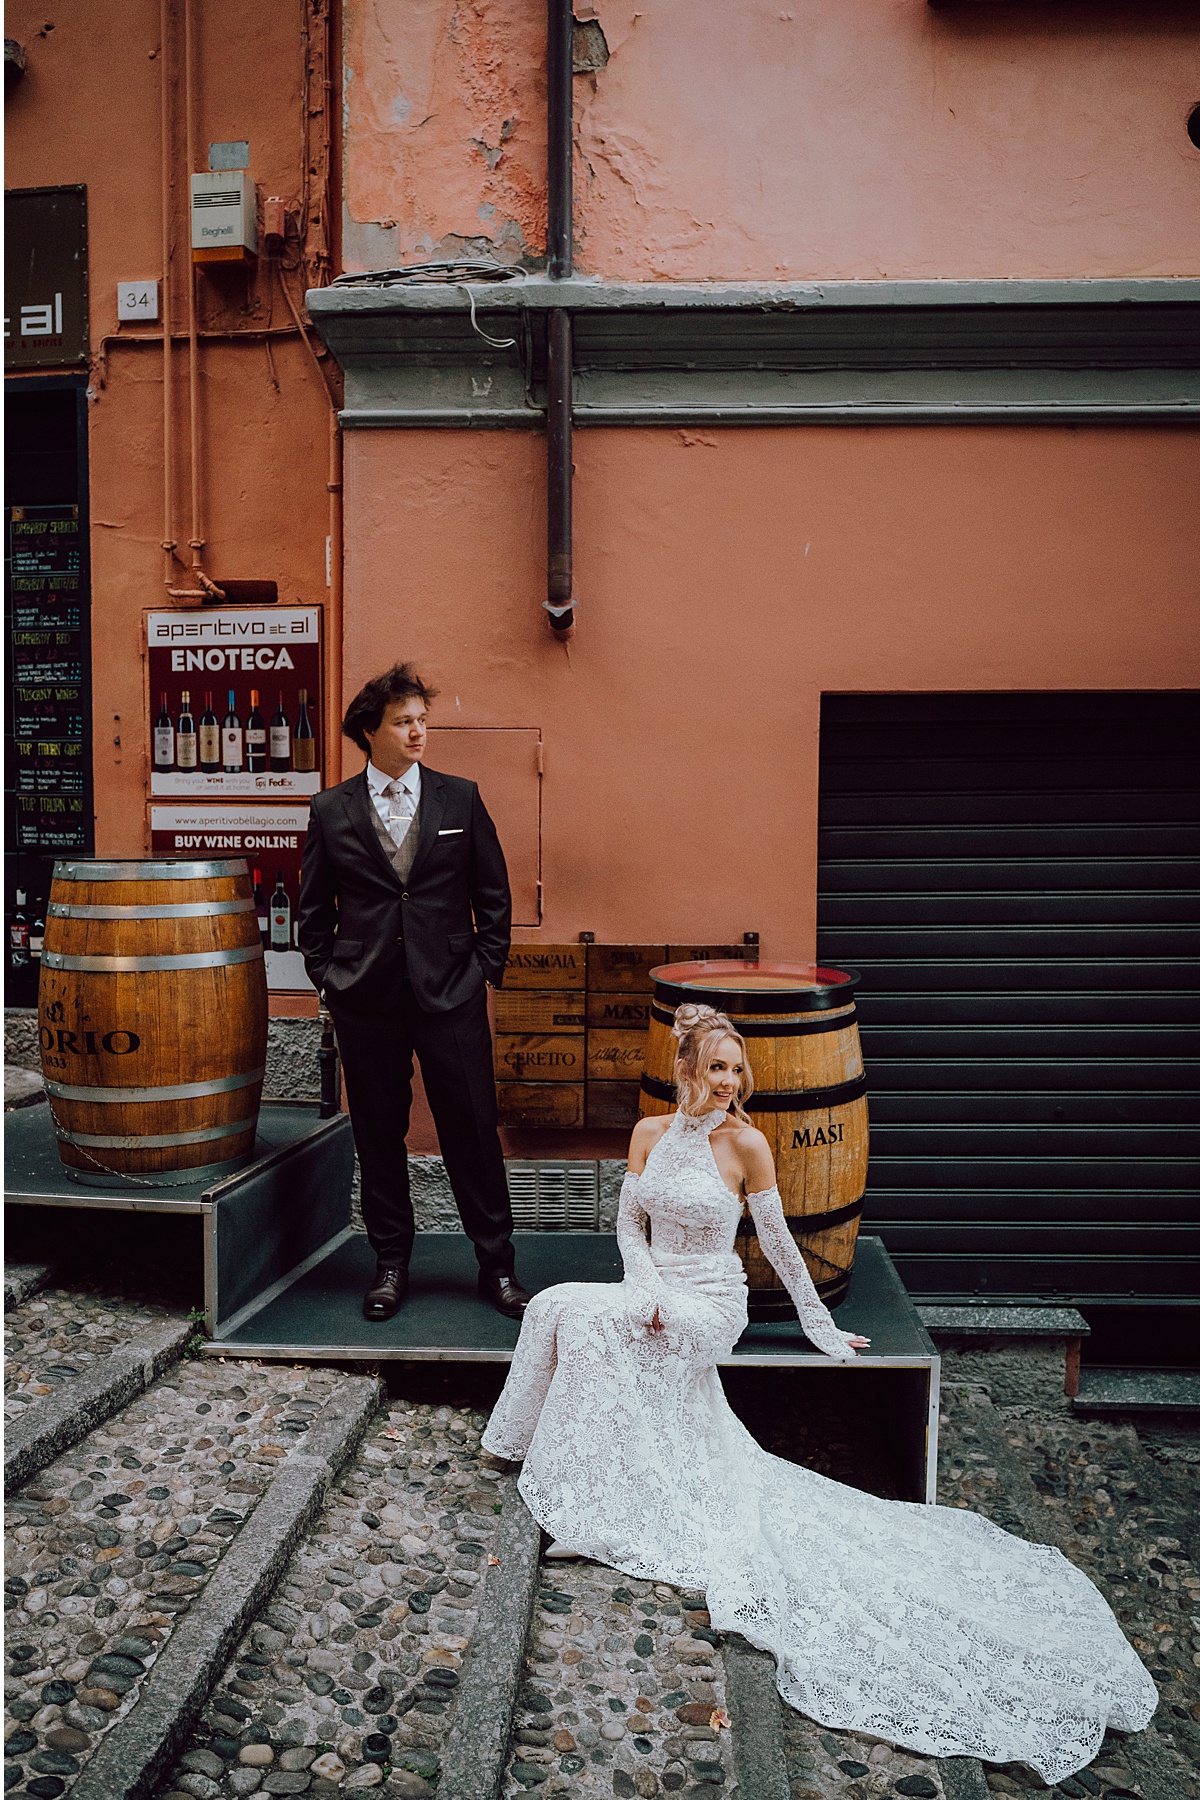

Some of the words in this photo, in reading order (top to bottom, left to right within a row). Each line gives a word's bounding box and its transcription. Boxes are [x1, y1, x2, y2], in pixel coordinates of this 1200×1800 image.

[201, 225, 234, 239] Beghelli
[126, 292, 149, 308] 34
[156, 618, 265, 640] aperitivo
[290, 616, 309, 634] al
[171, 647, 295, 672] ENOTECA
[268, 778, 293, 787] FedEx
[174, 816, 298, 829] www.aperitivobellagio.com
[174, 835, 202, 848] BUY
[202, 835, 242, 849] WINE
[244, 835, 299, 849] ONLINE
[603, 1004, 651, 1020] MASI
[791, 1122, 845, 1149] MASI
